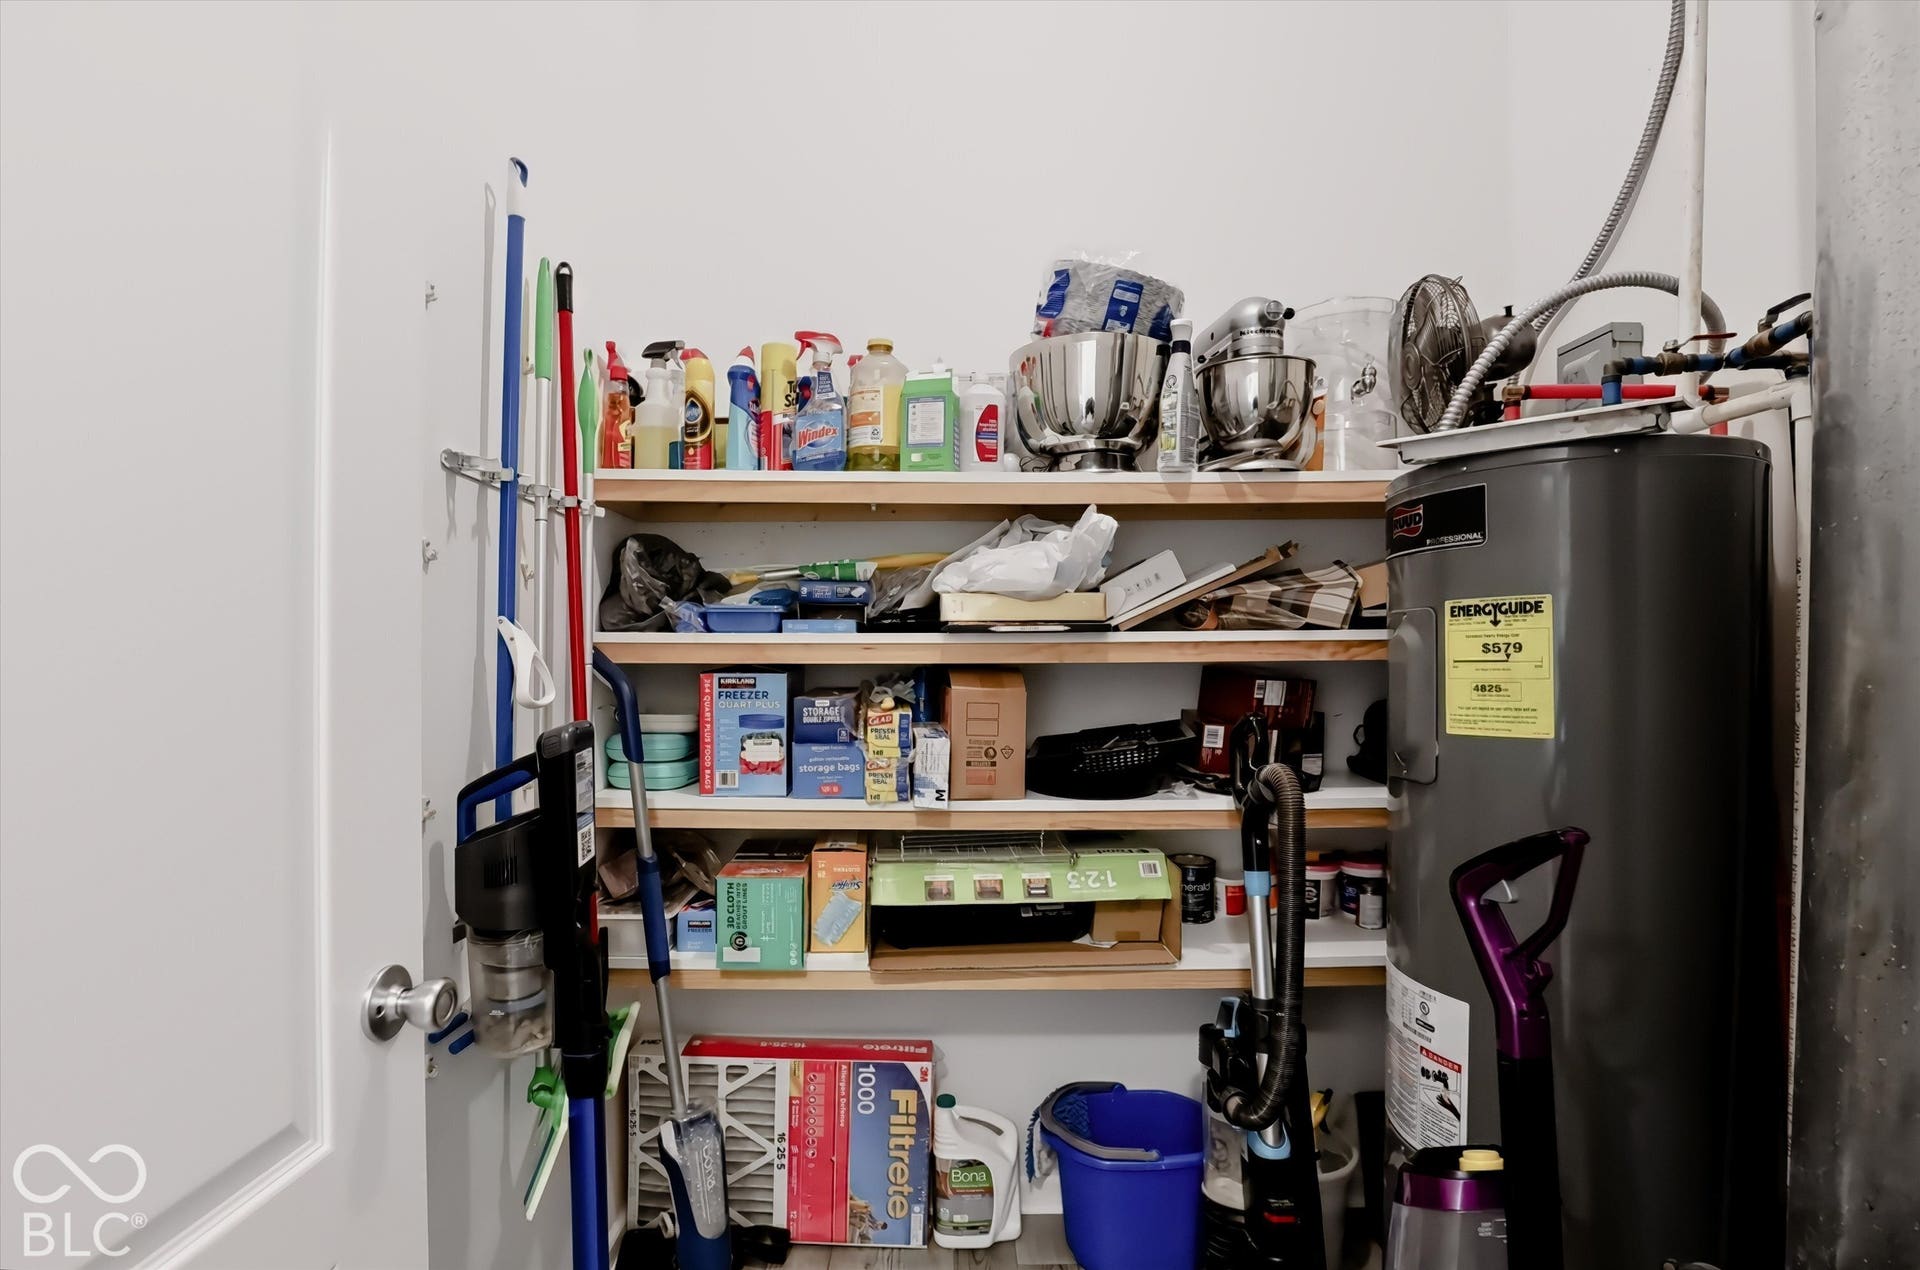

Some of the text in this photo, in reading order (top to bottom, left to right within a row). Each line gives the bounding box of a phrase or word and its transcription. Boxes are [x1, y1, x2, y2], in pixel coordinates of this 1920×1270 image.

[798, 425, 838, 449] Windex
[1393, 512, 1423, 532] RUUD
[1426, 532, 1484, 546] PROFESSIONAL
[1450, 600, 1544, 618] ENERGYGUIDE
[1482, 642, 1523, 654] $579
[1473, 684, 1502, 692] 4825
[718, 690, 768, 700] FREEZER
[803, 706, 840, 716] STORAGE
[869, 716, 892, 724] GLAD
[800, 763, 860, 773] storage bags
[935, 789, 946, 802] M
[832, 880, 863, 890] Swiffer
[727, 916, 734, 928] 3D
[862, 1044, 928, 1054] Filtrete
[1428, 1053, 1460, 1071] DANGER
[920, 1066, 928, 1082] 3M
[857, 1064, 876, 1114] 1000
[839, 1064, 847, 1128] Allergen Defense
[630, 1109, 636, 1118] 16
[630, 1120, 636, 1128] 25
[777, 1132, 786, 1144] 16
[777, 1148, 786, 1160] 25
[887, 1089, 918, 1220] Filtrete
[952, 1169, 986, 1182] Bona
